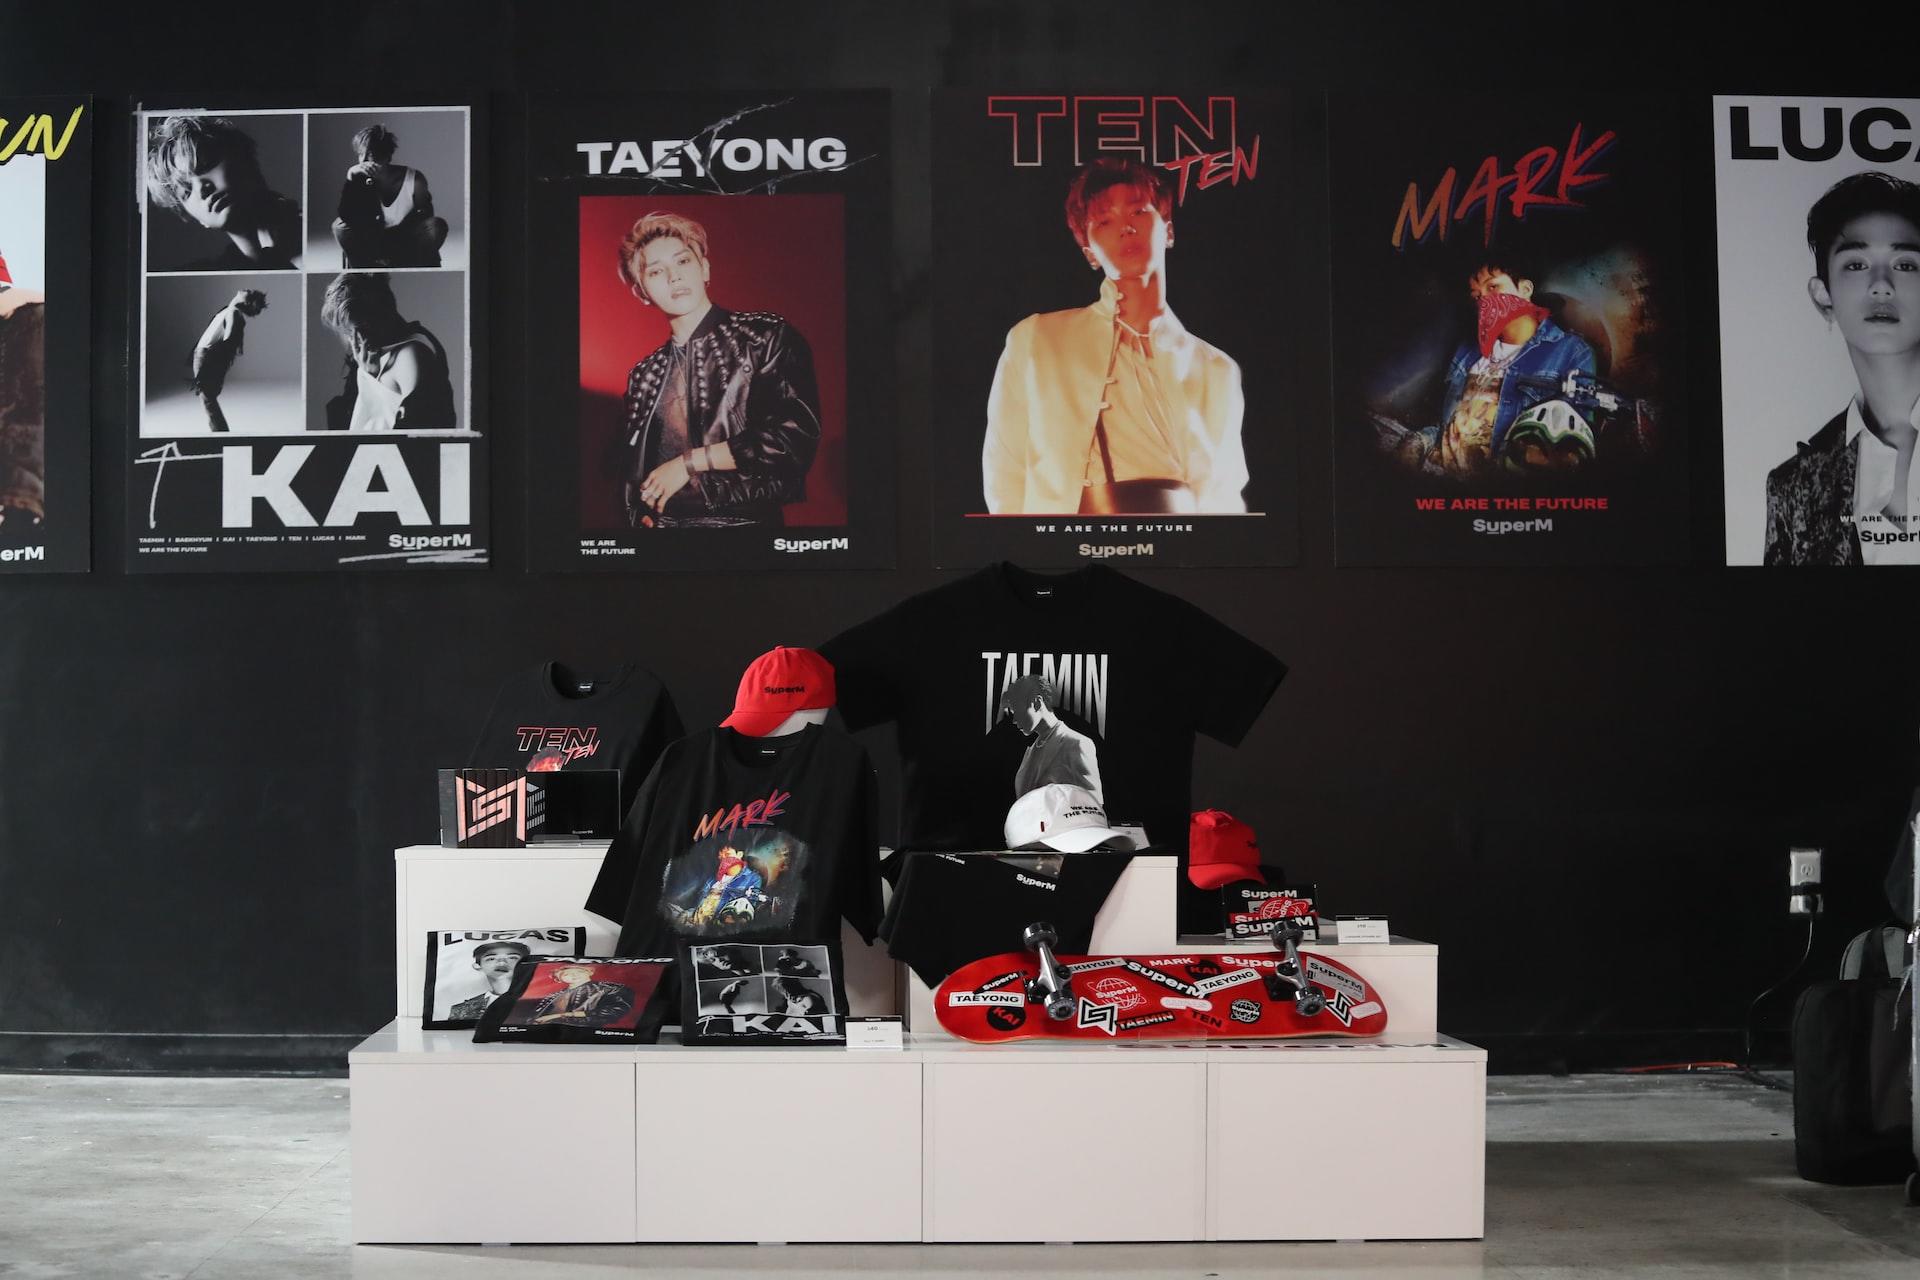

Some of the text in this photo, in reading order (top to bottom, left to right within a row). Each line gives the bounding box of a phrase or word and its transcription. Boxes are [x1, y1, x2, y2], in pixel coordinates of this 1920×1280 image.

[988, 96, 1236, 167] TEN
[1730, 106, 1920, 163] LUC
[577, 137, 847, 178] TAEYONG
[1164, 134, 1260, 208] TEN
[1392, 122, 1617, 250] MARK
[222, 443, 470, 528] KAI
[1416, 498, 1608, 510] WE ARE THE FUTURE
[1137, 524, 1193, 532] FUTURE
[1473, 518, 1552, 534] SuperM
[389, 533, 471, 550] SuperM
[774, 537, 849, 553] SuperM
[1861, 530, 1920, 545] Super
[1079, 543, 1153, 558] SuperM
[764, 686, 805, 694] SuperM
[516, 727, 598, 752] TEN
[563, 740, 600, 765] TEN
[693, 789, 791, 842] MARK
[1016, 873, 1056, 892] SuperM
[1241, 889, 1297, 899] SuperM
[1235, 916, 1314, 935] SupM
[444, 929, 570, 946] LUCAS
[1149, 957, 1193, 967] MARK
[982, 972, 1018, 991] SuperM
[1126, 962, 1206, 999] SuperM
[1200, 971, 1254, 990] TAEYONG
[1310, 962, 1363, 991] SuperM
[956, 995, 1019, 1003] TAEYONG
[1095, 985, 1137, 999] SuperM
[732, 1015, 838, 1034] KAI
[993, 1006, 1020, 1025] KAI
[1120, 1012, 1174, 1029] TAEMIN
[1191, 1011, 1223, 1028] TEN
